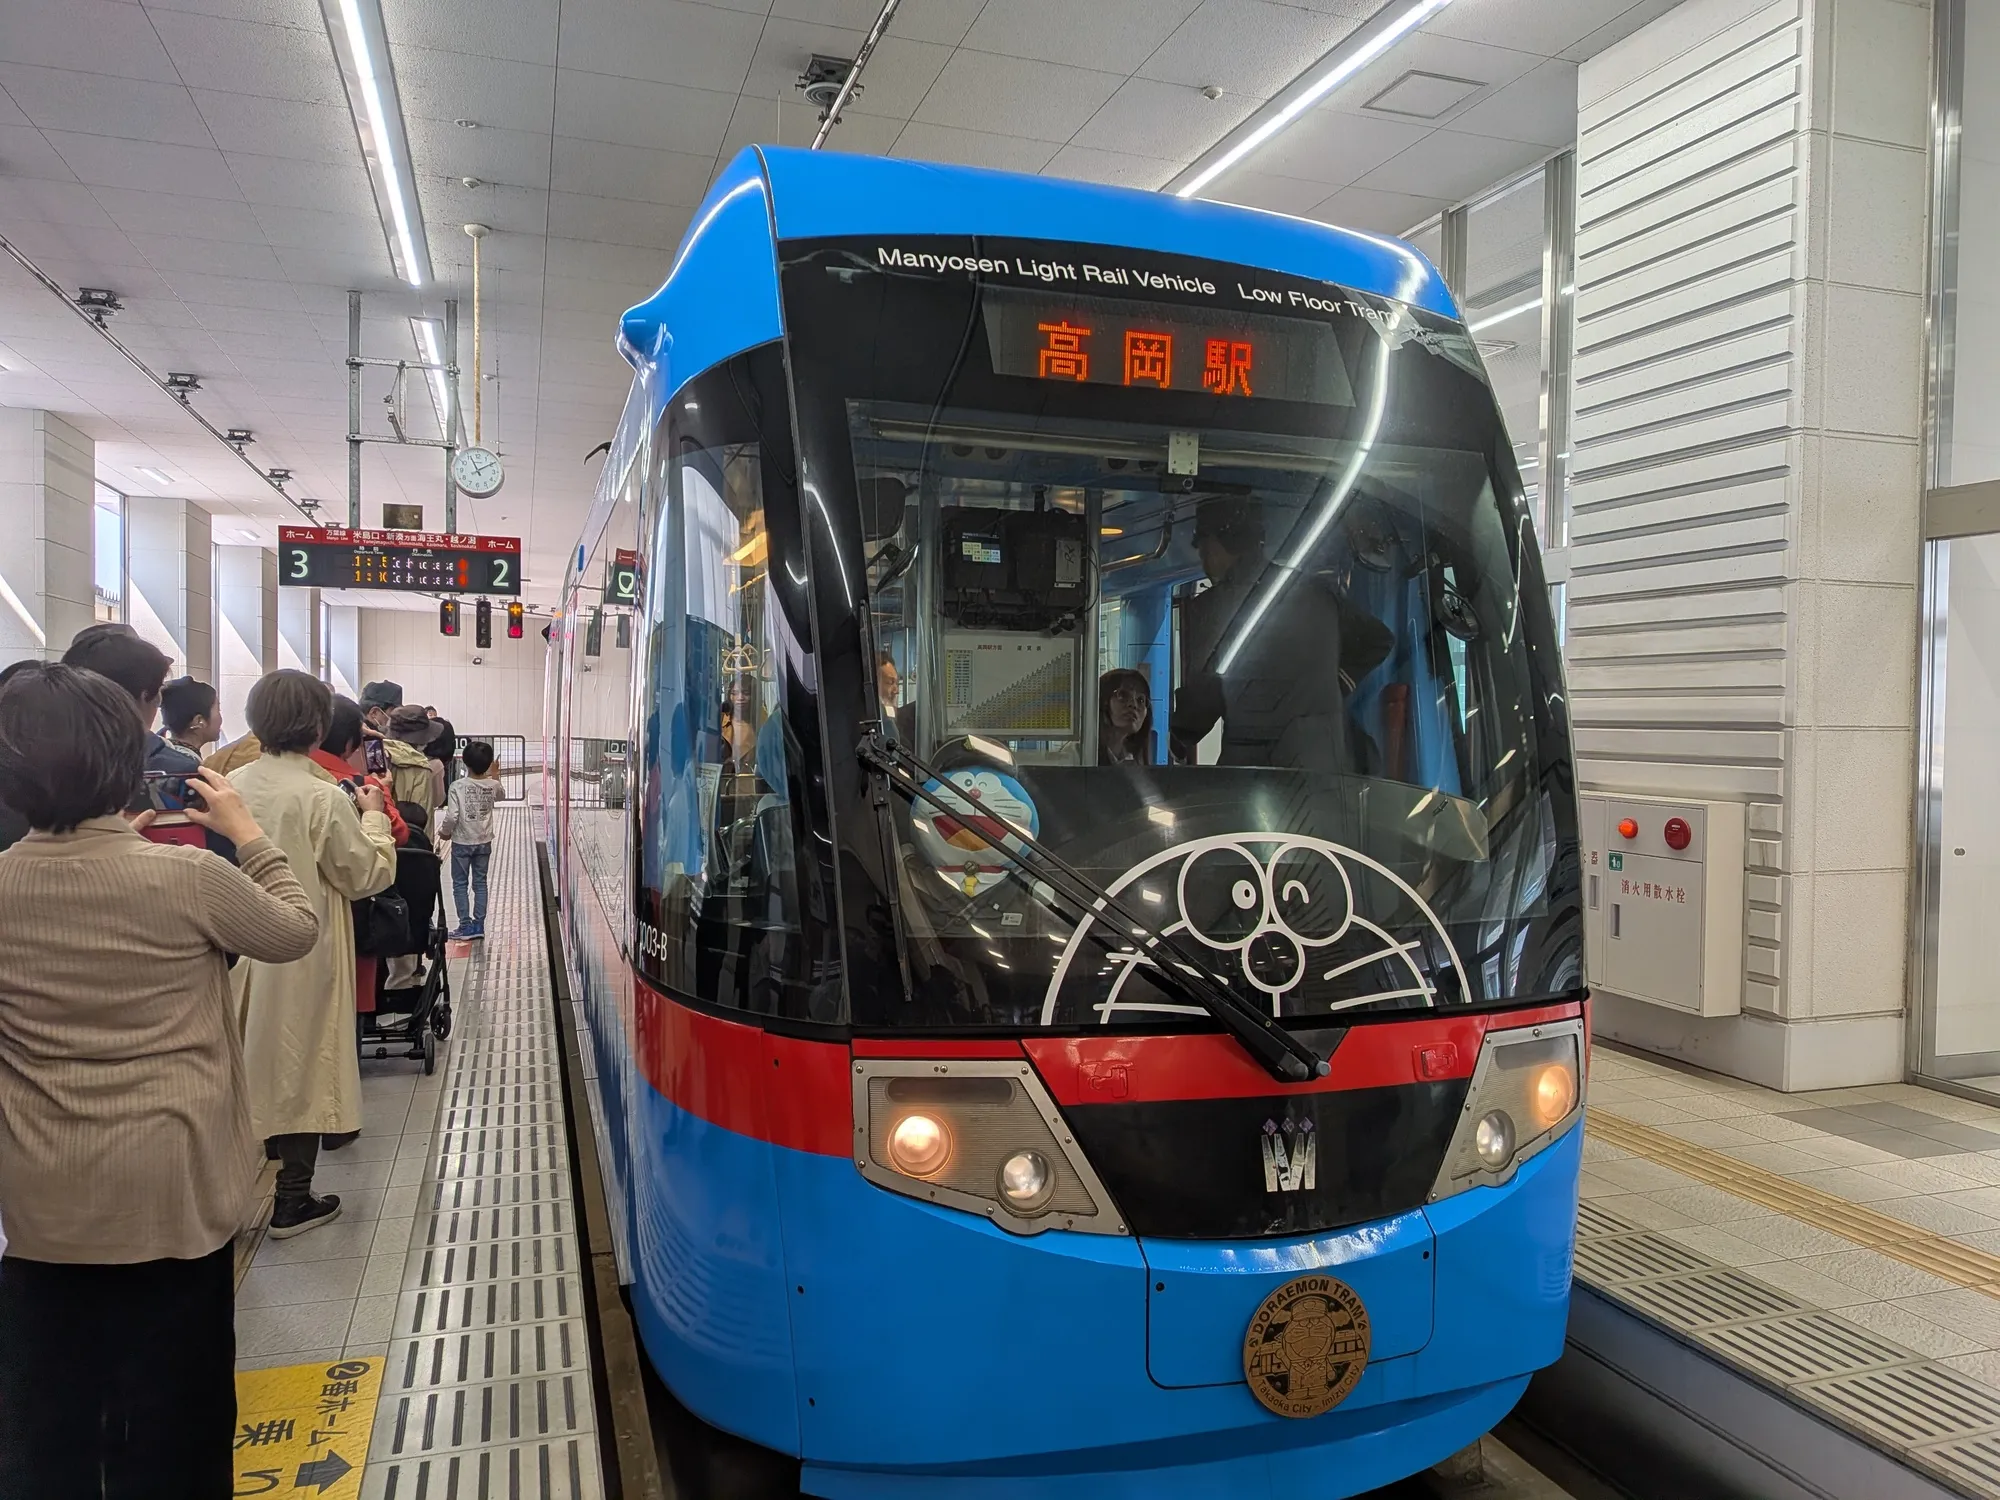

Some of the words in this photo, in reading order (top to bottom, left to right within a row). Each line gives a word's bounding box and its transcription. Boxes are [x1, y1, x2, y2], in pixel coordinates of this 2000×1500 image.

[878, 247, 1009, 273] Manyosen
[1016, 258, 1077, 284] Light
[1083, 264, 1130, 286] Rail
[1132, 270, 1217, 295] Vehicle
[1237, 283, 1282, 304] Low
[1288, 290, 1341, 314] Floor
[1037, 320, 1254, 397] 高岡駅
[286, 529, 315, 540] ホーム
[487, 540, 514, 549] ホーム
[290, 550, 308, 578] 3
[492, 559, 509, 587] 2
[1621, 879, 1686, 904] 消火用散水栓
[1253, 1278, 1330, 1335] DORAEMON
[1334, 1282, 1366, 1321] TRAM
[1257, 1379, 1290, 1412] Takaoka
[1292, 1404, 1312, 1413] City
[1321, 1389, 1345, 1408] Imizu
[1343, 1364, 1360, 1388] City
